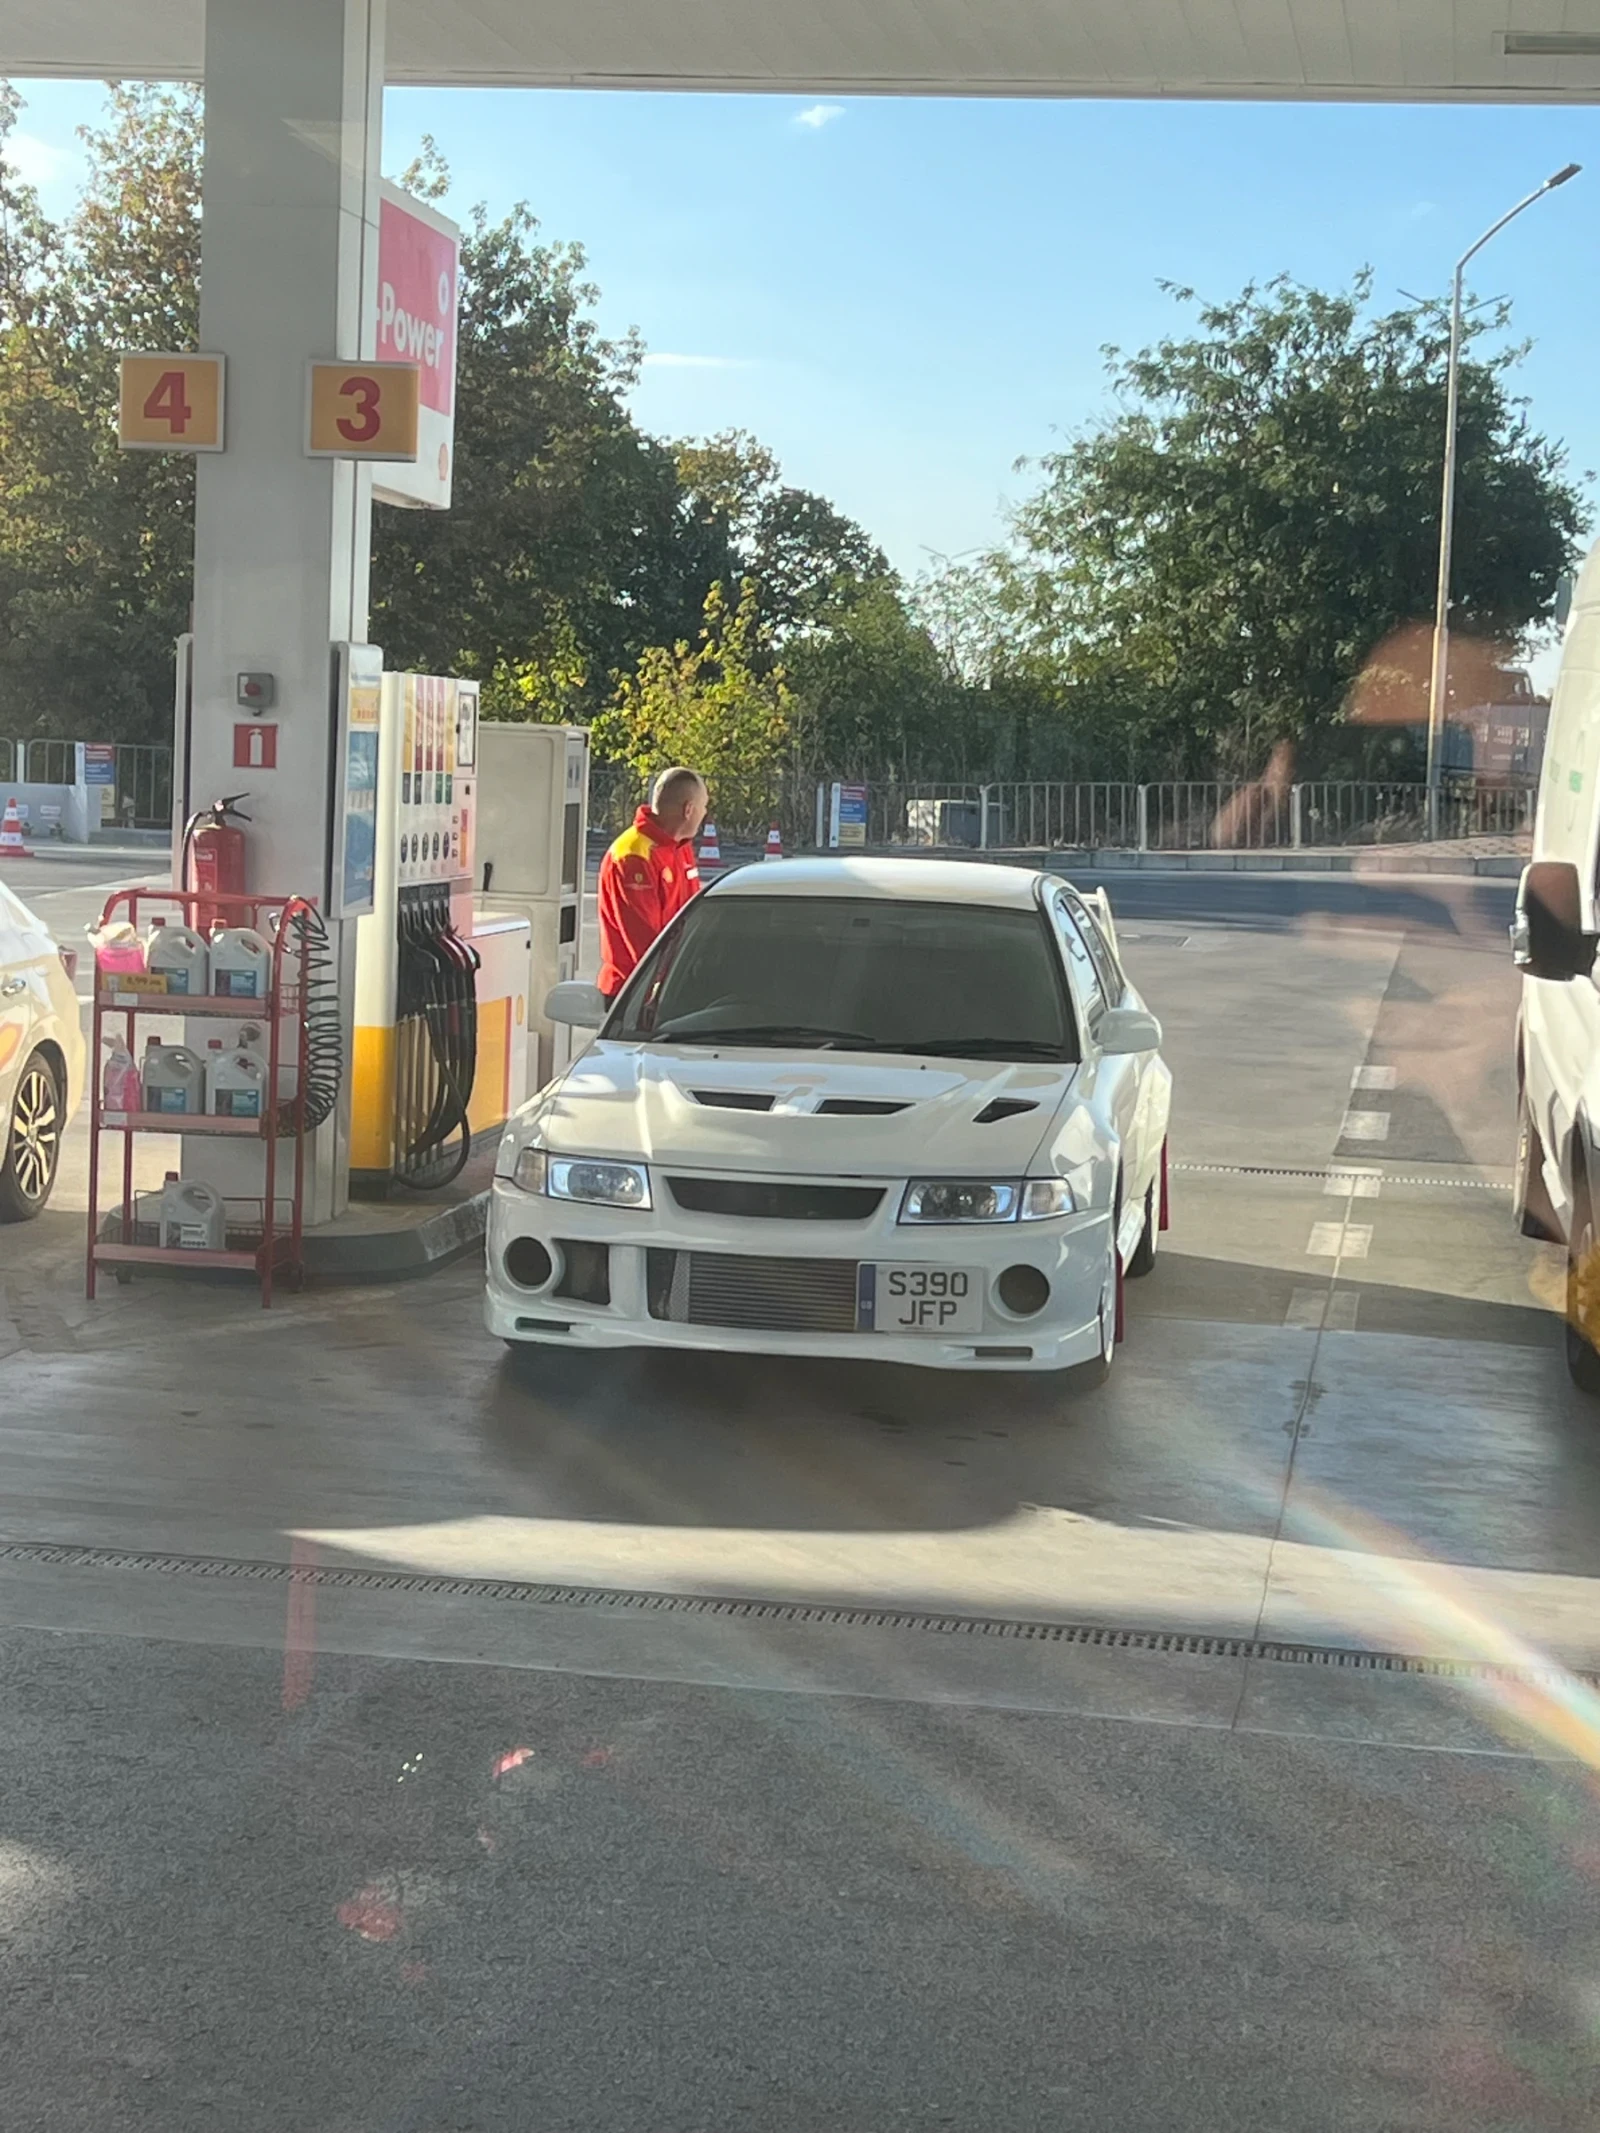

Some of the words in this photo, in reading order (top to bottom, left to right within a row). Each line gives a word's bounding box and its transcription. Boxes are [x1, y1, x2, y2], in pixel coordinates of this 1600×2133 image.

[143, 371, 192, 434] 4
[336, 376, 382, 442] 3
[888, 1271, 969, 1297] S390
[898, 1300, 957, 1326] JFP
